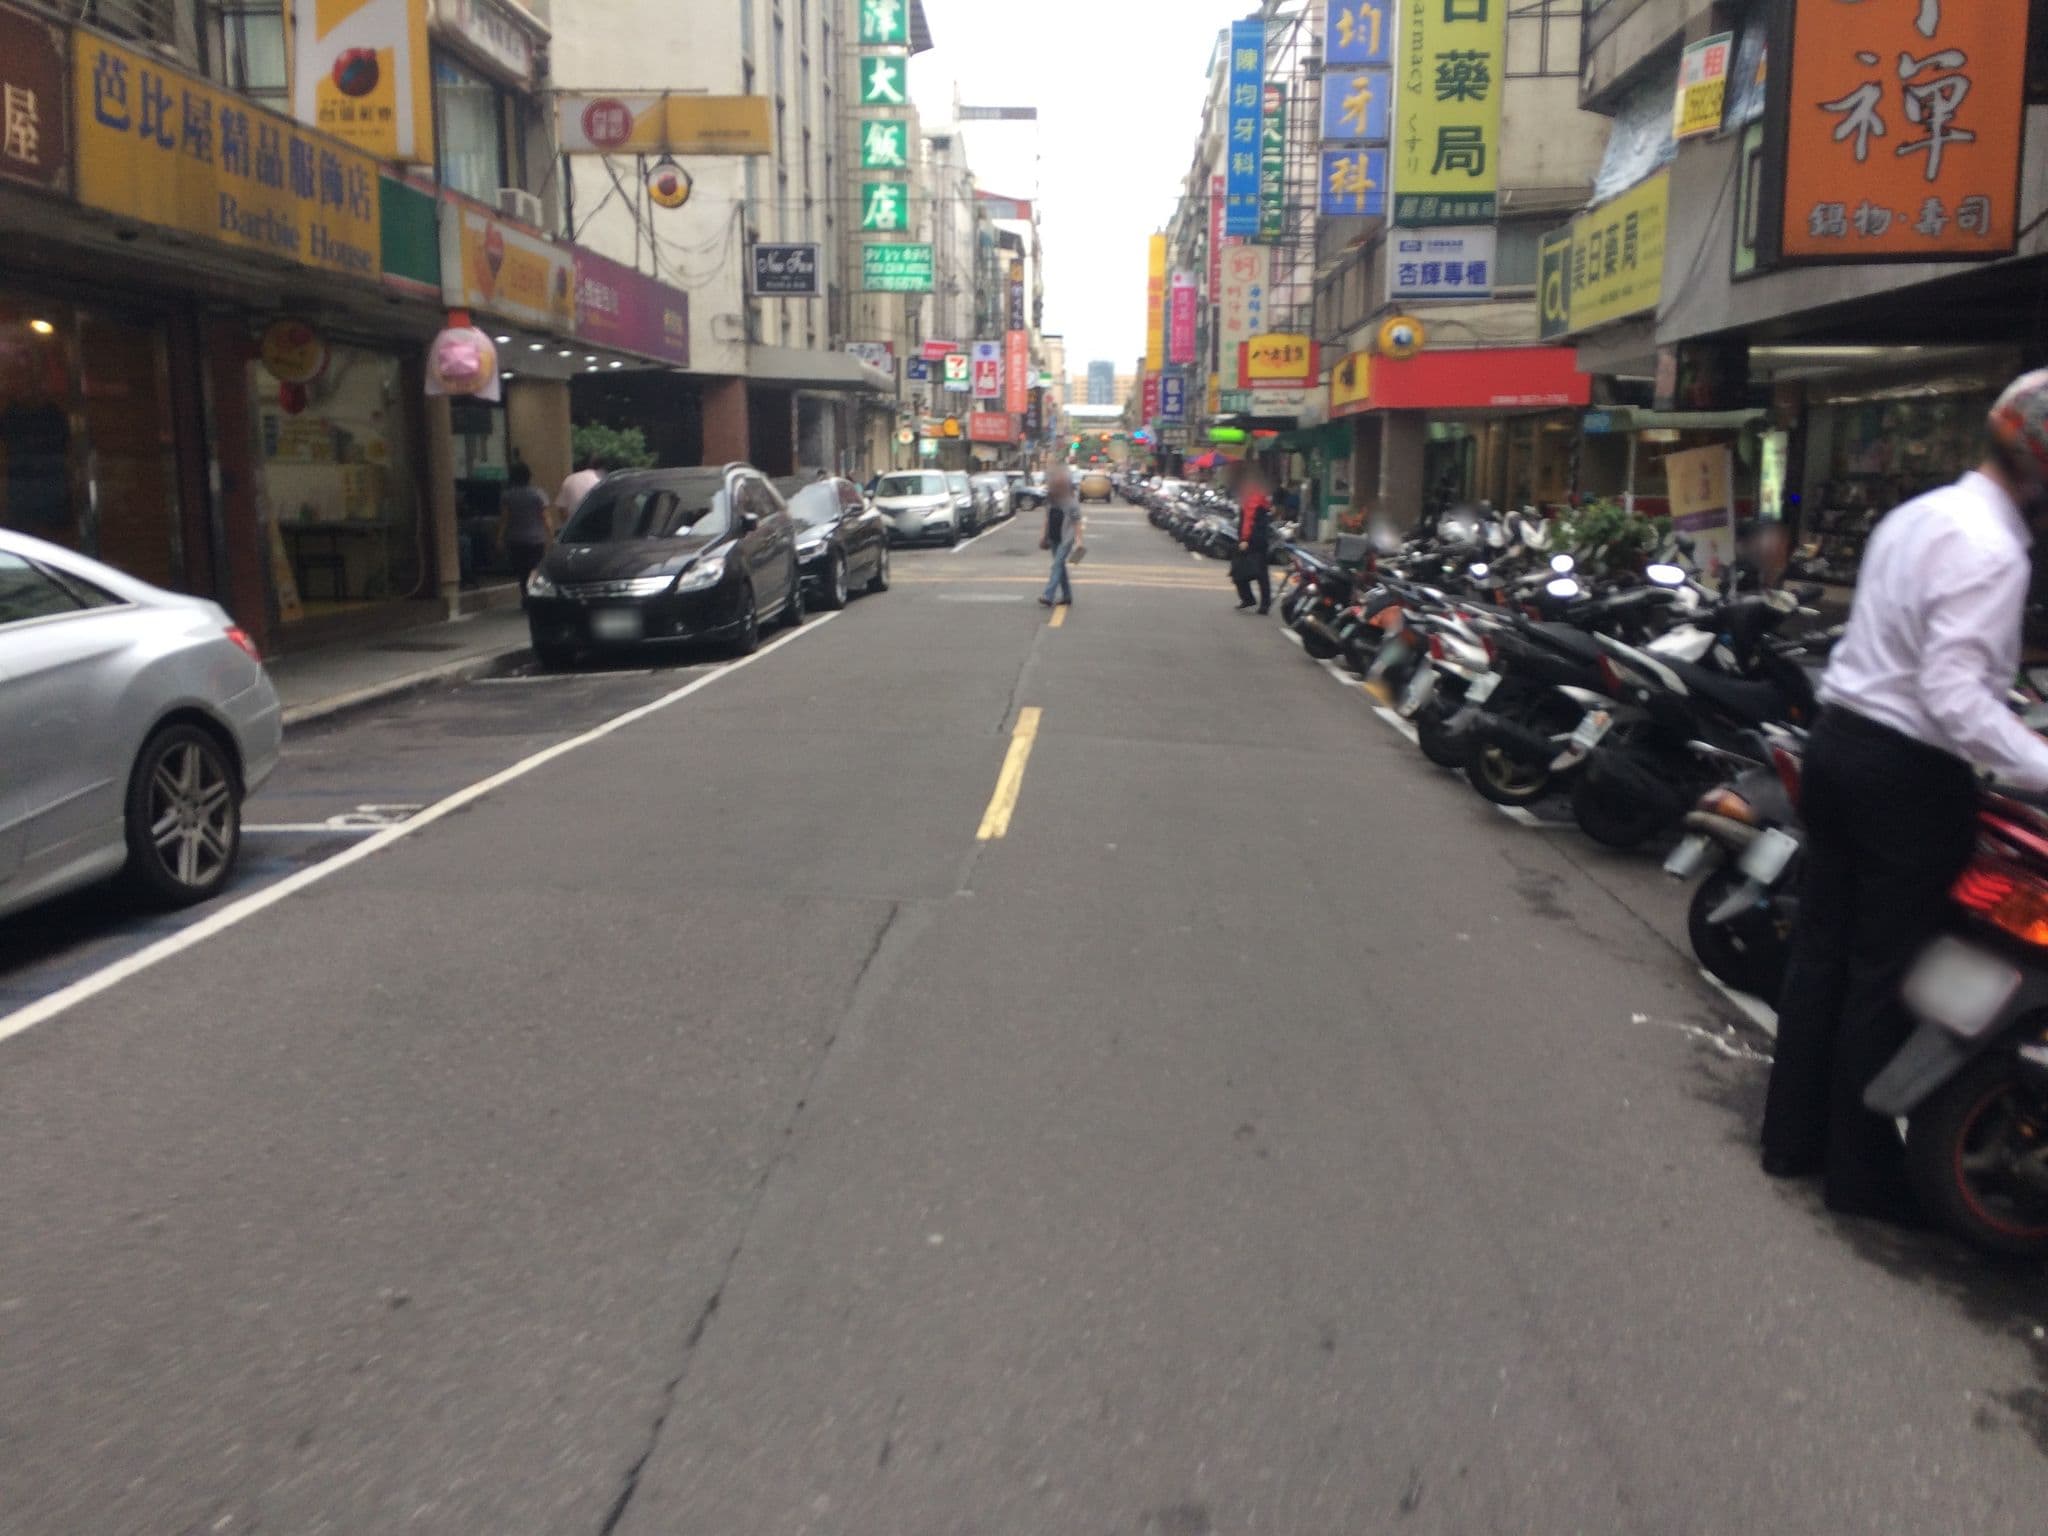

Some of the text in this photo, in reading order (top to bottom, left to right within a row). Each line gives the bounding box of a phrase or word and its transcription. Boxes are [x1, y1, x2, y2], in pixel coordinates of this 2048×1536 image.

[1232, 48, 1258, 176] 陳均牙科
[1398, 260, 1487, 286] 杏輝專櫃
